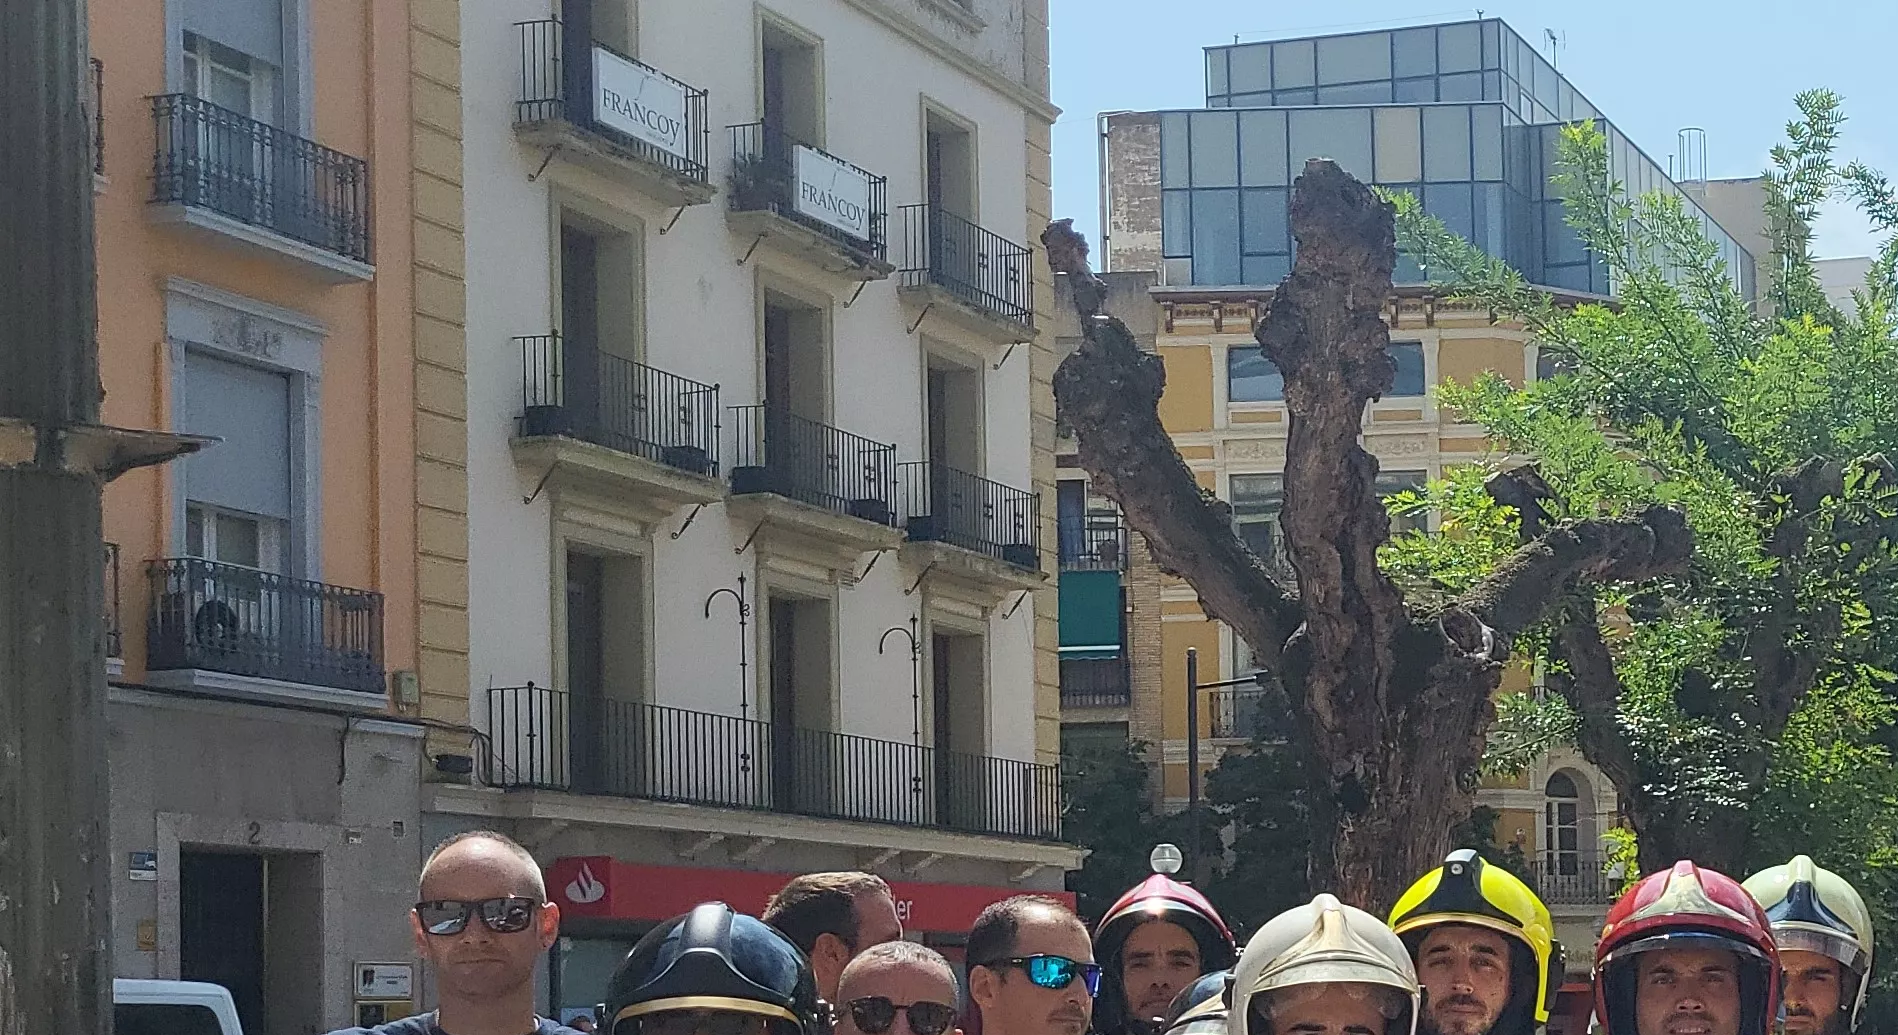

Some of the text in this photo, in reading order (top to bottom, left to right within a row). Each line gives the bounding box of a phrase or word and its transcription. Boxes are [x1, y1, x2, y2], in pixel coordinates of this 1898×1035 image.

[602, 88, 681, 147] FRANCOY
[801, 181, 866, 231] FRANCOY
[248, 821, 262, 845] 2
